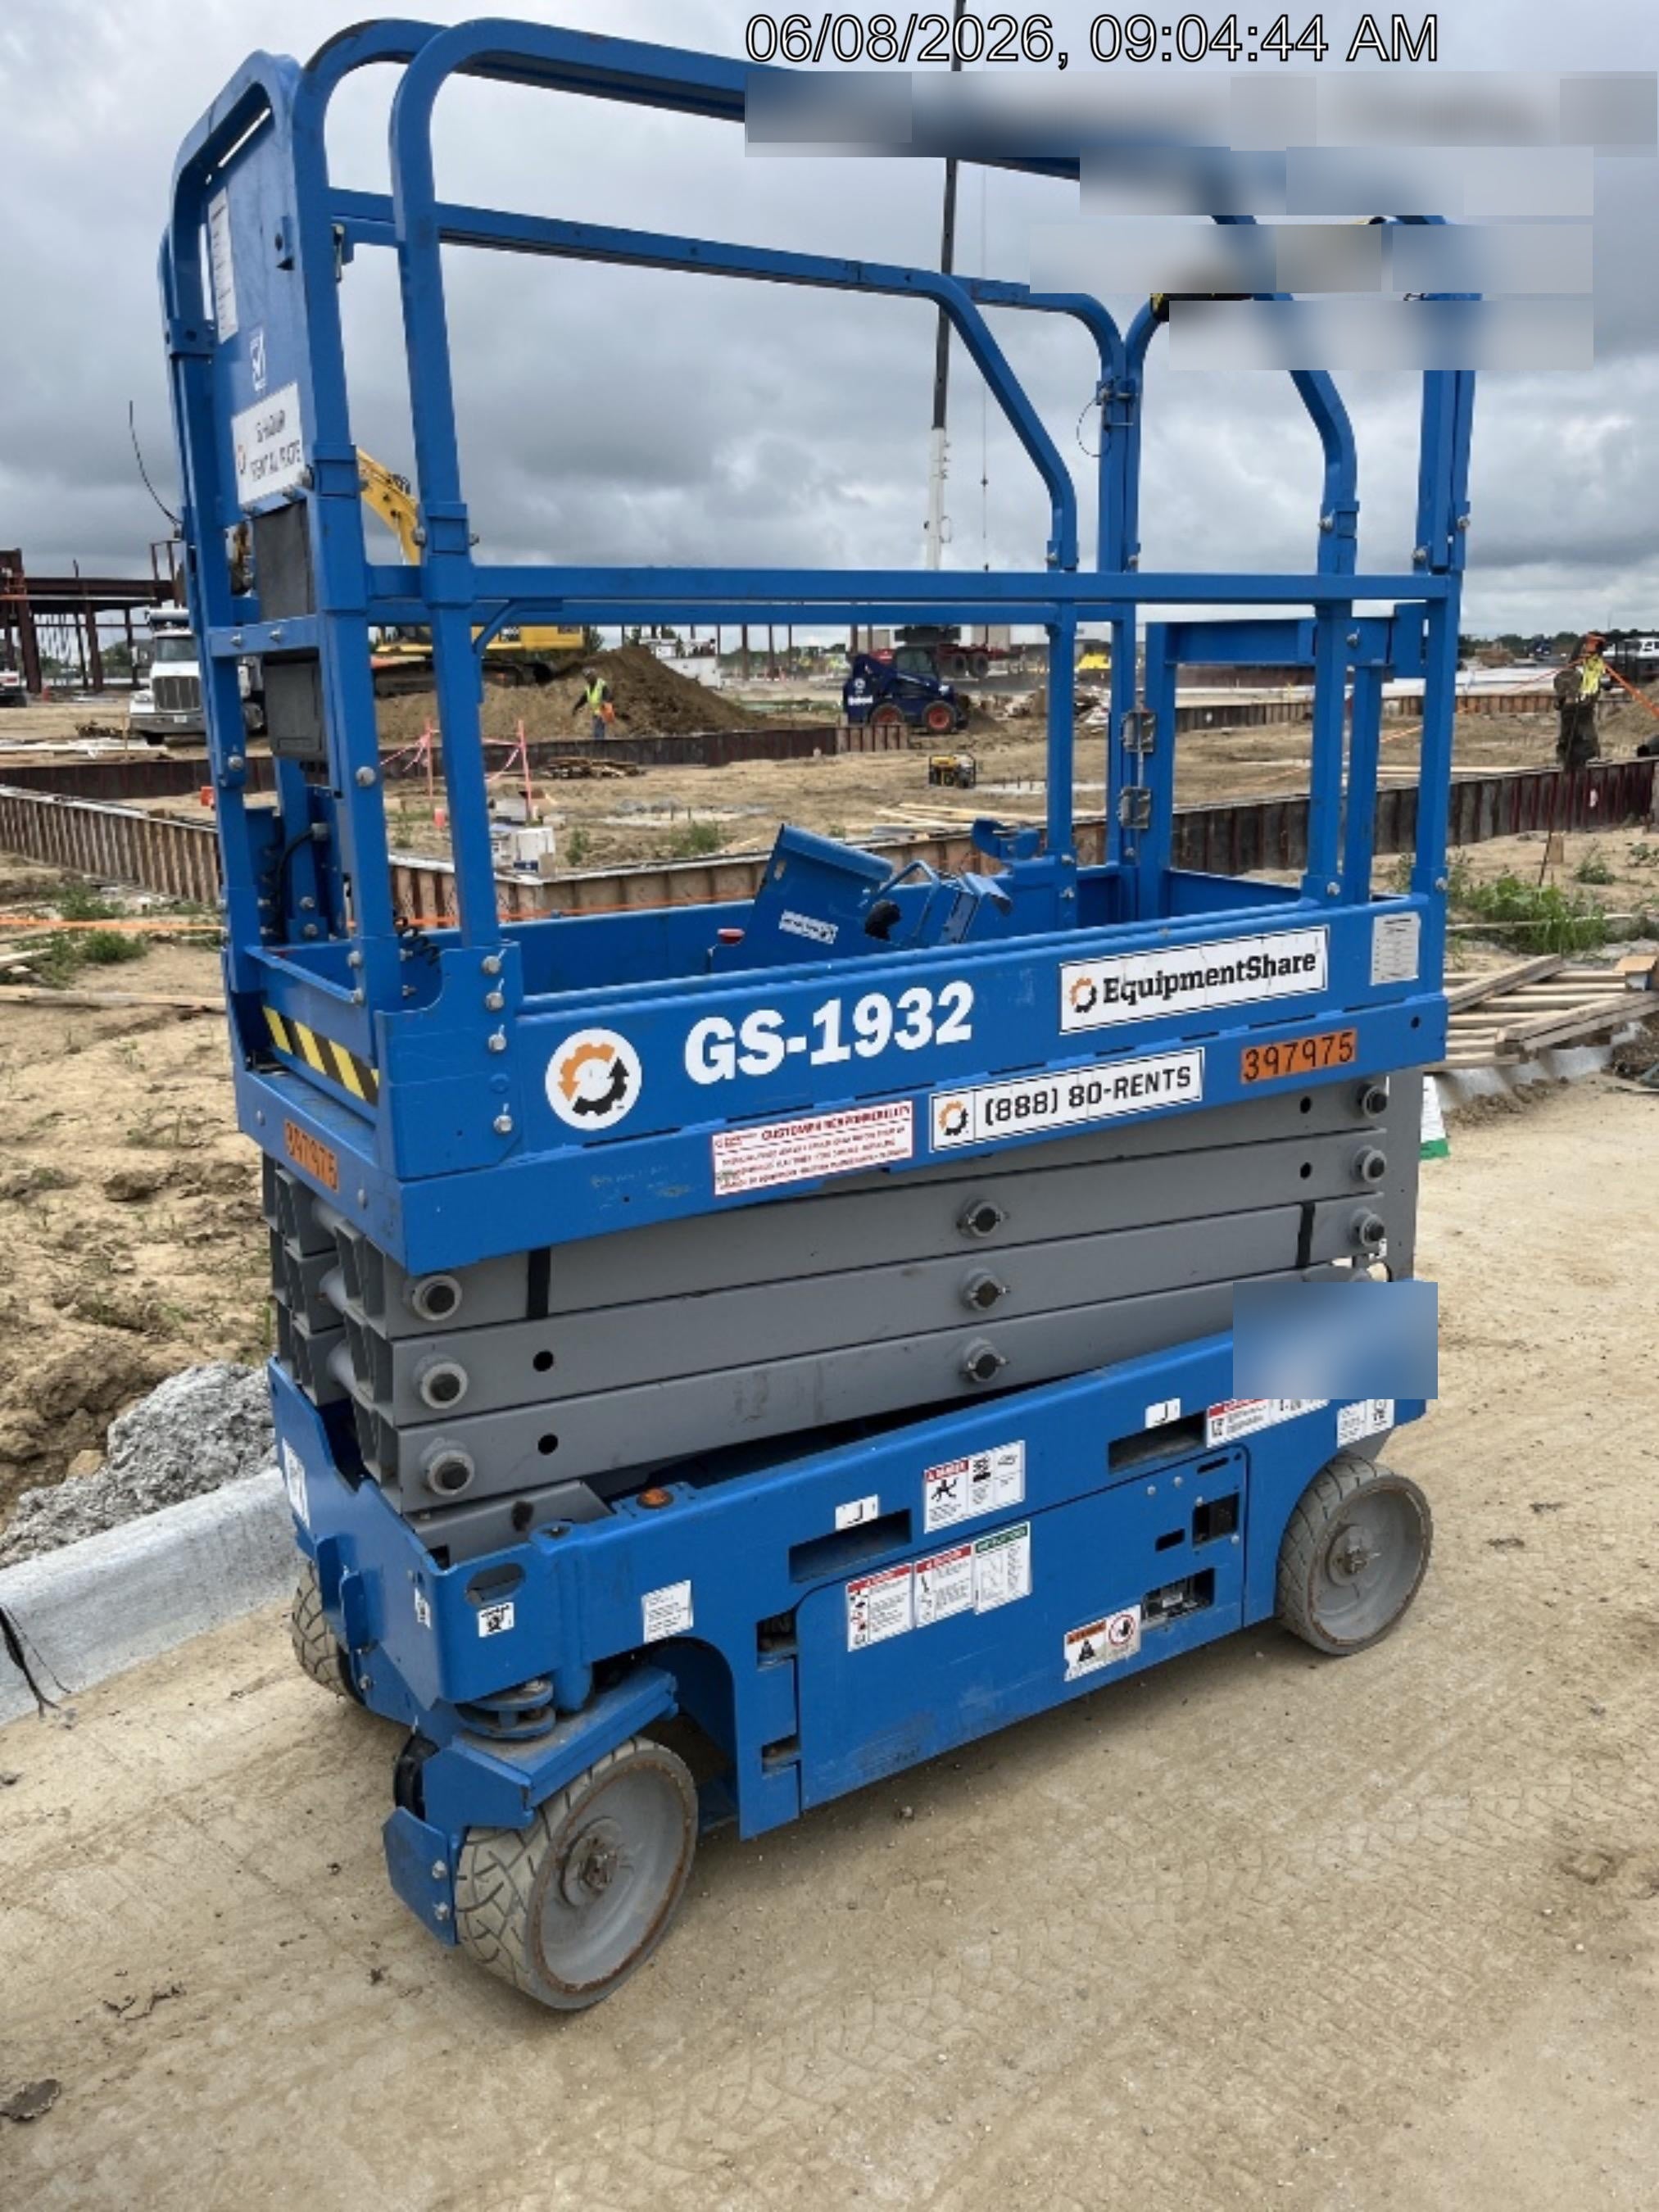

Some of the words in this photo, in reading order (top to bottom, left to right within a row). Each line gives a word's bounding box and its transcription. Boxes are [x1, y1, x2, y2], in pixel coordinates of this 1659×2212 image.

[1103, 951, 1317, 1006] EquipmentShare
[684, 980, 974, 1085] GS-1932
[1244, 1031, 1353, 1082] 397975
[985, 1090, 1058, 1127] (888)
[1067, 1065, 1191, 1108] 80-RENTS
